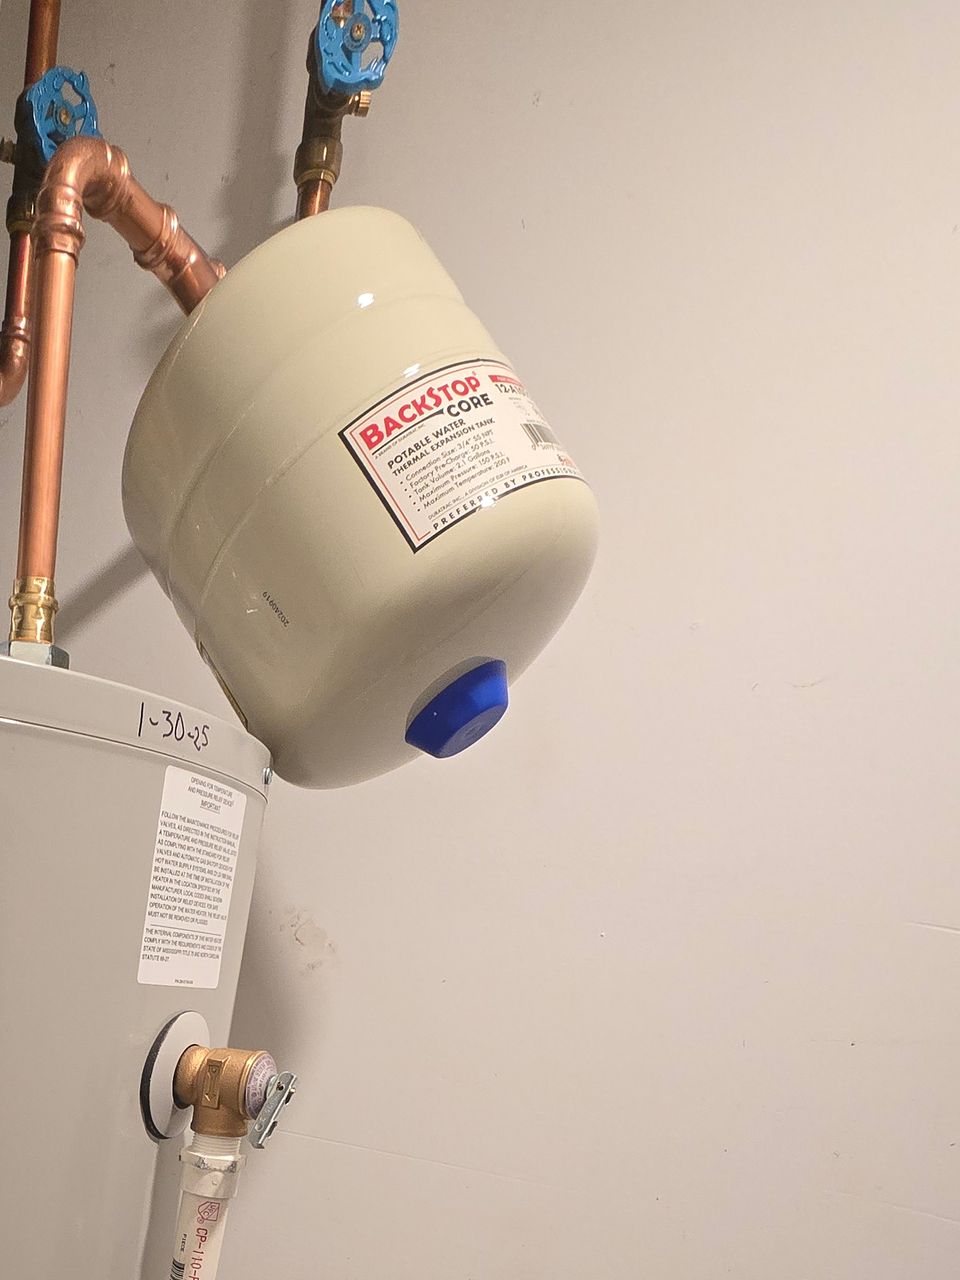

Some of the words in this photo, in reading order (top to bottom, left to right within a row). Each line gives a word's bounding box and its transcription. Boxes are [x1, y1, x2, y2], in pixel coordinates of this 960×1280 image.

[359, 375, 480, 451] BACKSTOP
[447, 393, 494, 417] CORE
[387, 436, 432, 470] POTABLE
[432, 418, 466, 438] WATER
[392, 449, 430, 476] THERMAL
[430, 424, 475, 452] EXPANSION
[476, 417, 495, 430] TANK
[406, 457, 440, 481] Connection
[441, 448, 458, 458] Size:
[410, 470, 434, 488] Factory
[414, 482, 430, 495] Tank
[430, 466, 456, 484] Volume:
[468, 450, 491, 462] Gallons
[420, 480, 451, 502] Maximum
[450, 465, 478, 481] Pressure:
[504, 478, 517, 489] BY
[424, 486, 455, 509] Maximum
[454, 466, 495, 488] Temperature:
